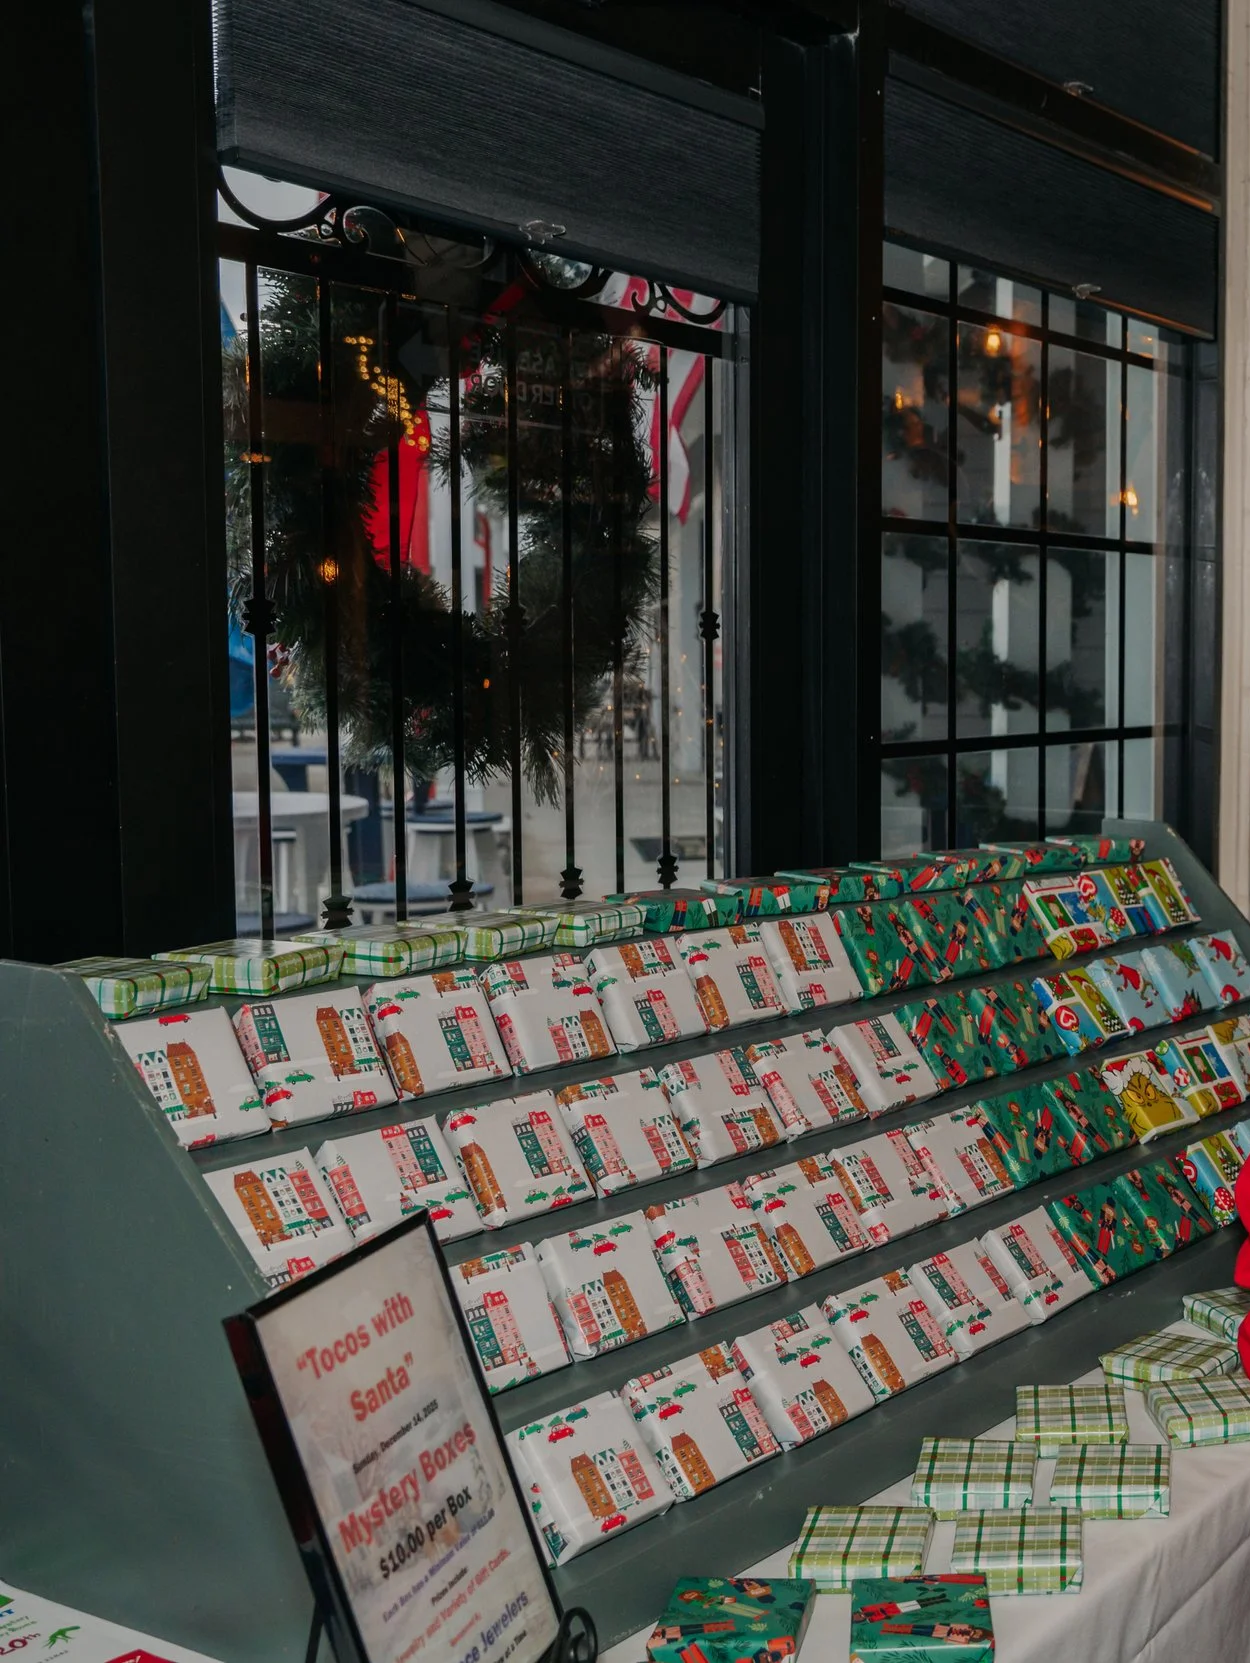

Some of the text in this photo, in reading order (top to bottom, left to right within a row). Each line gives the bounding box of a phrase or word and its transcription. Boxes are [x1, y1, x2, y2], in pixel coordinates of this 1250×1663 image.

[371, 1292, 415, 1338] with
[337, 1422, 477, 1554] Mystery Boxes
[380, 1486, 473, 1580] $10.00 per Box
[480, 1590, 529, 1653] Jewelers
